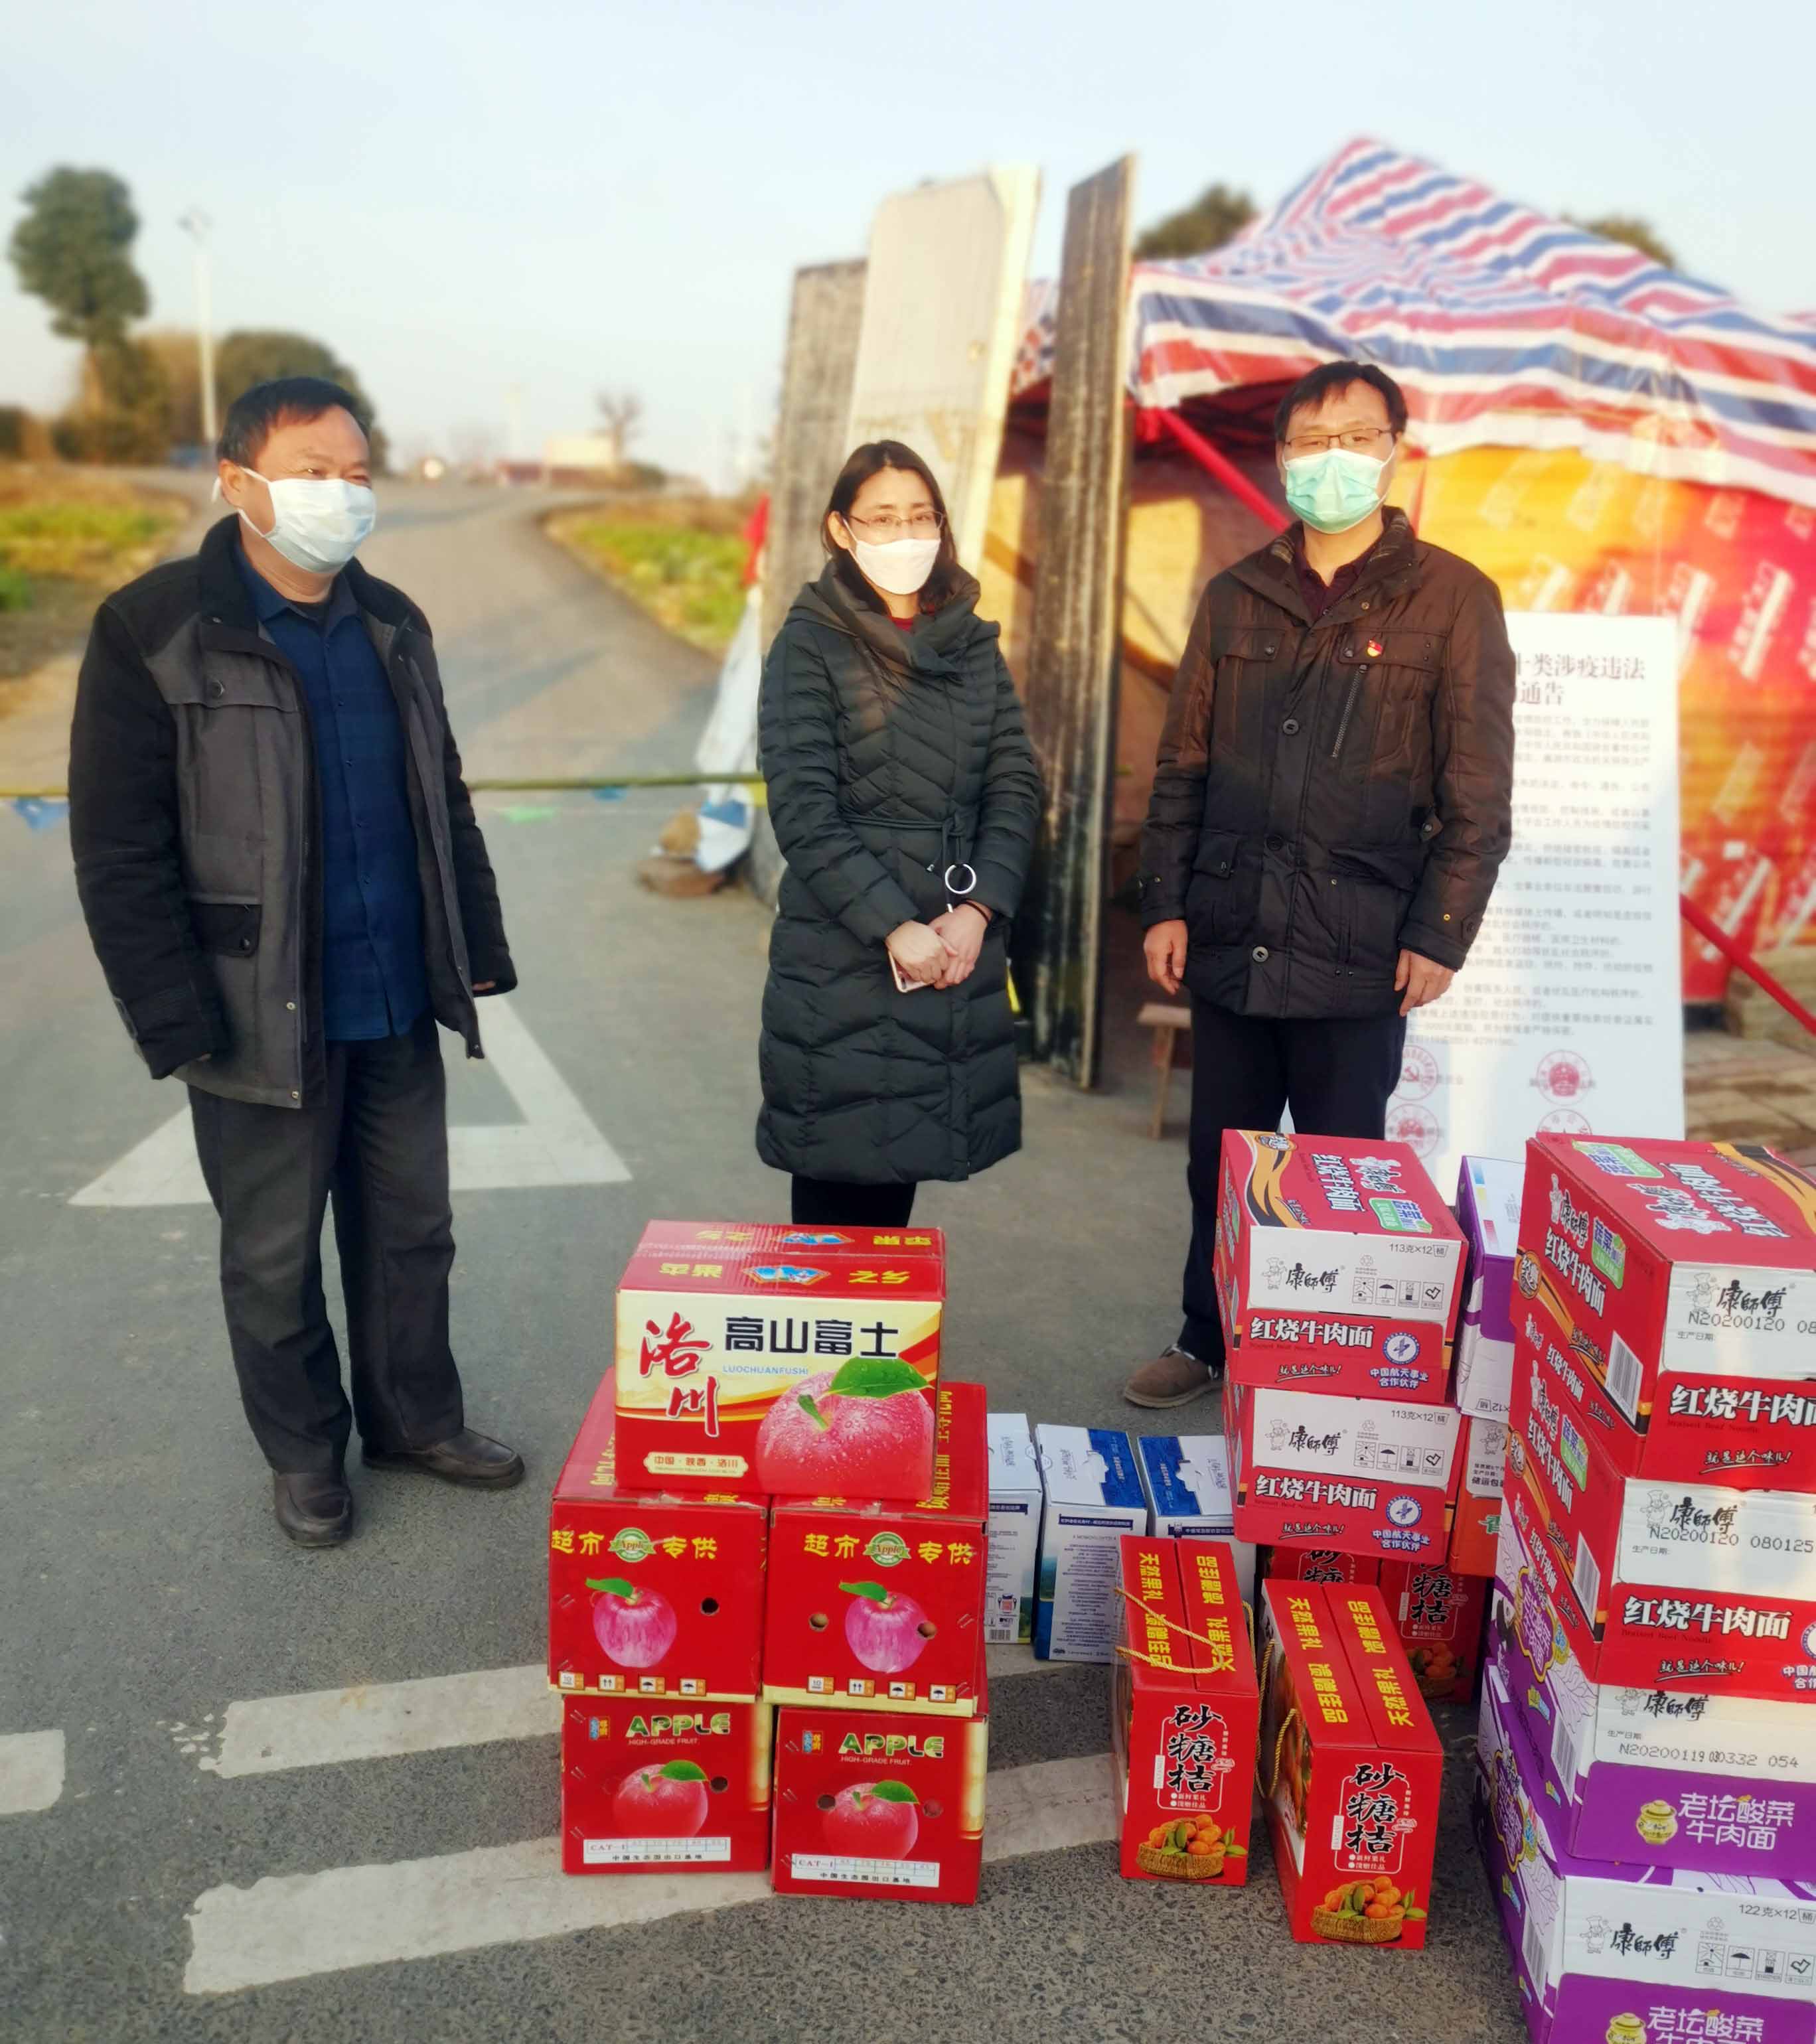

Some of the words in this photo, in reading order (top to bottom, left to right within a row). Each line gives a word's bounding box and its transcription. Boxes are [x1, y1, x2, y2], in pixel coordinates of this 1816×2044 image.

[1514, 682, 1564, 705] 通告
[848, 1270, 911, 1284] 之乡
[1286, 1262, 1339, 1293] 康師傅
[1545, 1227, 1607, 1317] 红烧牛肉面
[1716, 1279, 1787, 1317] 康師傅
[1250, 1316, 1375, 1349] 红烧牛肉面
[1688, 1311, 1785, 1331] N20200120
[725, 1315, 899, 1360] 高山富士
[1370, 1367, 1428, 1382] 中国航天事业
[1379, 1377, 1419, 1389] 合作伙伴
[1289, 1425, 1343, 1456] 康師傅
[1255, 1473, 1379, 1510] 红烧牛肉面
[1669, 1496, 1738, 1534] 康師傅
[552, 1529, 605, 1556] 超市
[662, 1535, 718, 1560] 专供
[803, 1532, 861, 1559] 超市
[917, 1540, 974, 1566] 专供
[1372, 1528, 1430, 1546] 中国航天事业
[1381, 1538, 1421, 1552] 合作伙伴
[1649, 1526, 1739, 1546] N20200120
[1750, 1535, 1815, 1554] 080125
[1138, 1552, 1164, 1602] 天然果礼
[1411, 1563, 1455, 1625] 糖桔
[1286, 1596, 1329, 1652] 天然果礼
[1623, 1595, 1793, 1640] 红烧牛肉面
[1371, 1666, 1416, 1727] 天然果礼
[1643, 1690, 1710, 1721] 康師傅
[625, 1712, 731, 1738] APPLE
[838, 1732, 945, 1759] APPLE
[1166, 1704, 1225, 1794] 砂糖桔
[1619, 1743, 1704, 1764] N20200119
[1768, 1755, 1800, 1769] 054
[889, 1757, 911, 1767] FRUIT
[1345, 1762, 1407, 1854] 砂糖桔
[1677, 1793, 1796, 1827] 老坛酸菜
[1685, 1820, 1777, 1851] 牛肉面
[1611, 1923, 1679, 1960] 康師傅
[1647, 2006, 1764, 2042] 老坛酸菜
